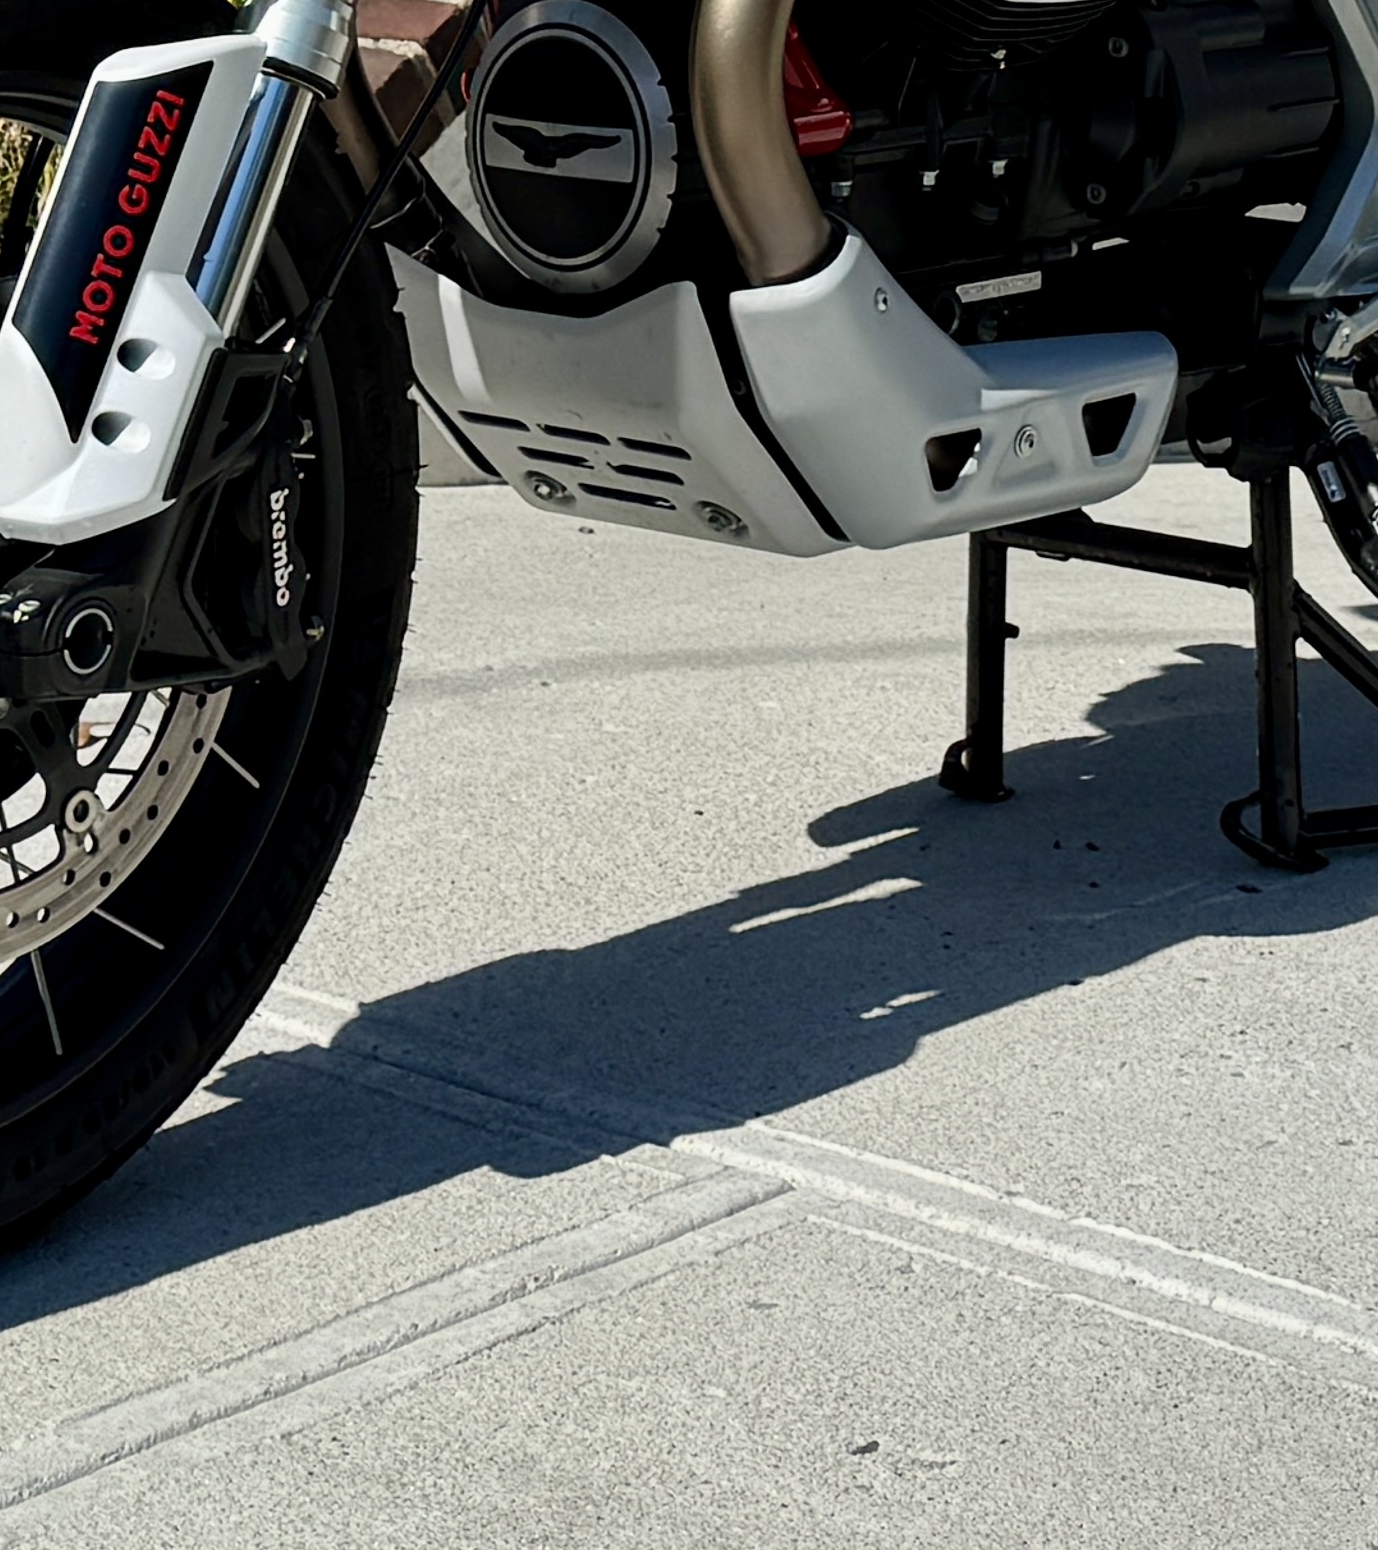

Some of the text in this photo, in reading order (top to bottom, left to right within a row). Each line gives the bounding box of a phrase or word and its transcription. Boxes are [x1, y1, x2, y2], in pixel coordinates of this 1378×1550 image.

[69, 89, 185, 344] MOTO GUZZI
[270, 487, 295, 607] brembo
